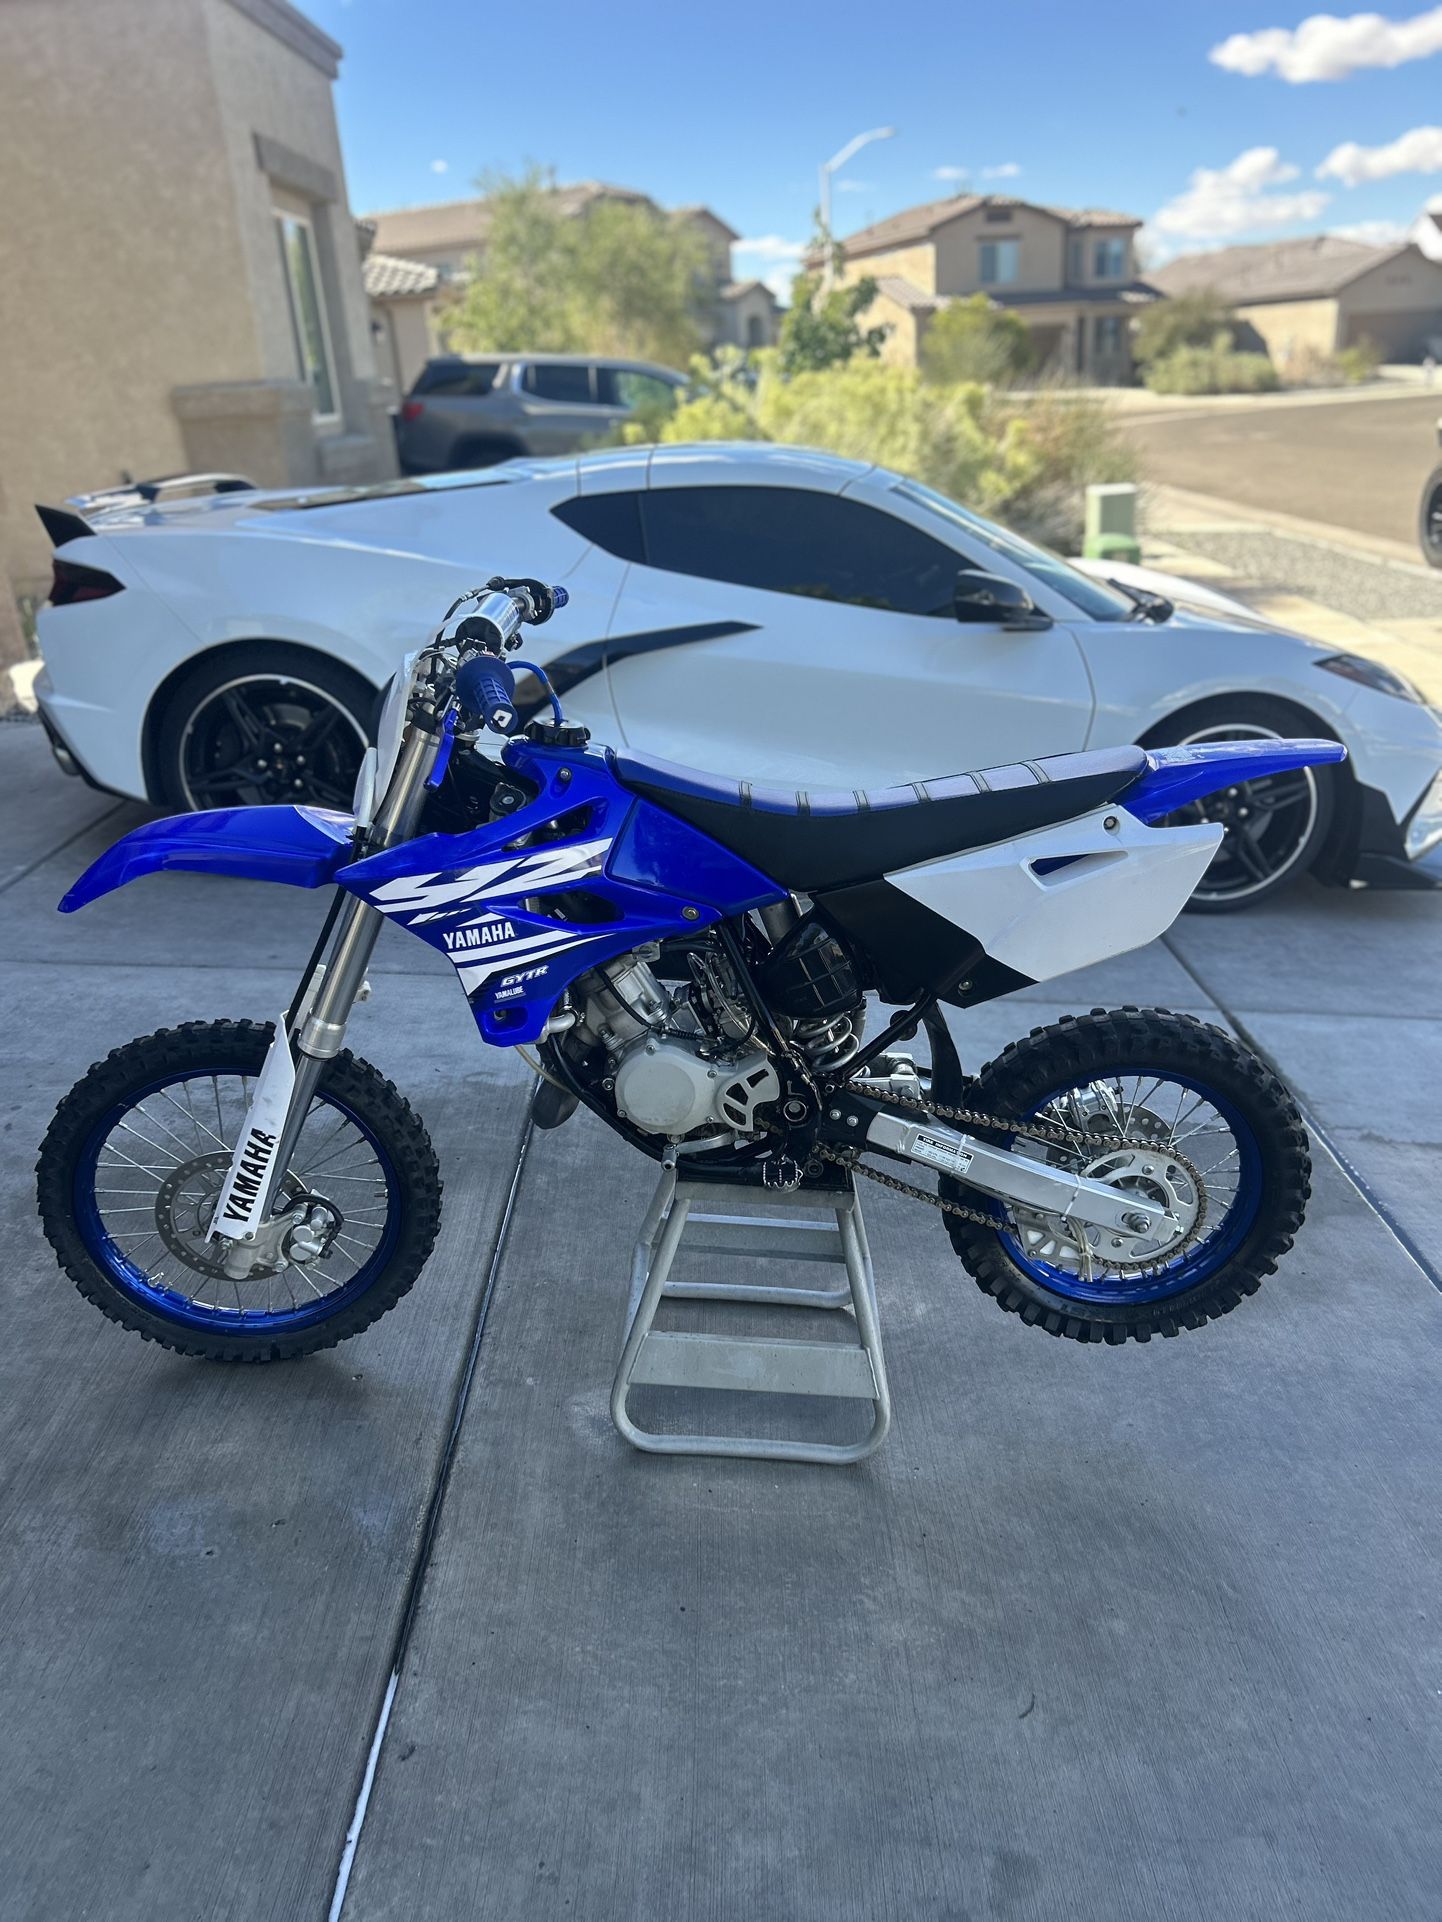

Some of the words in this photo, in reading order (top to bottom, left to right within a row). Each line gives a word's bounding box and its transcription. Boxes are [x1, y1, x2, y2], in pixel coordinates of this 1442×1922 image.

[443, 922, 515, 949] YAMAHA
[501, 965, 549, 987] GYTR
[495, 986, 524, 999] YAMALUBE
[223, 1128, 276, 1222] YAMAHA
